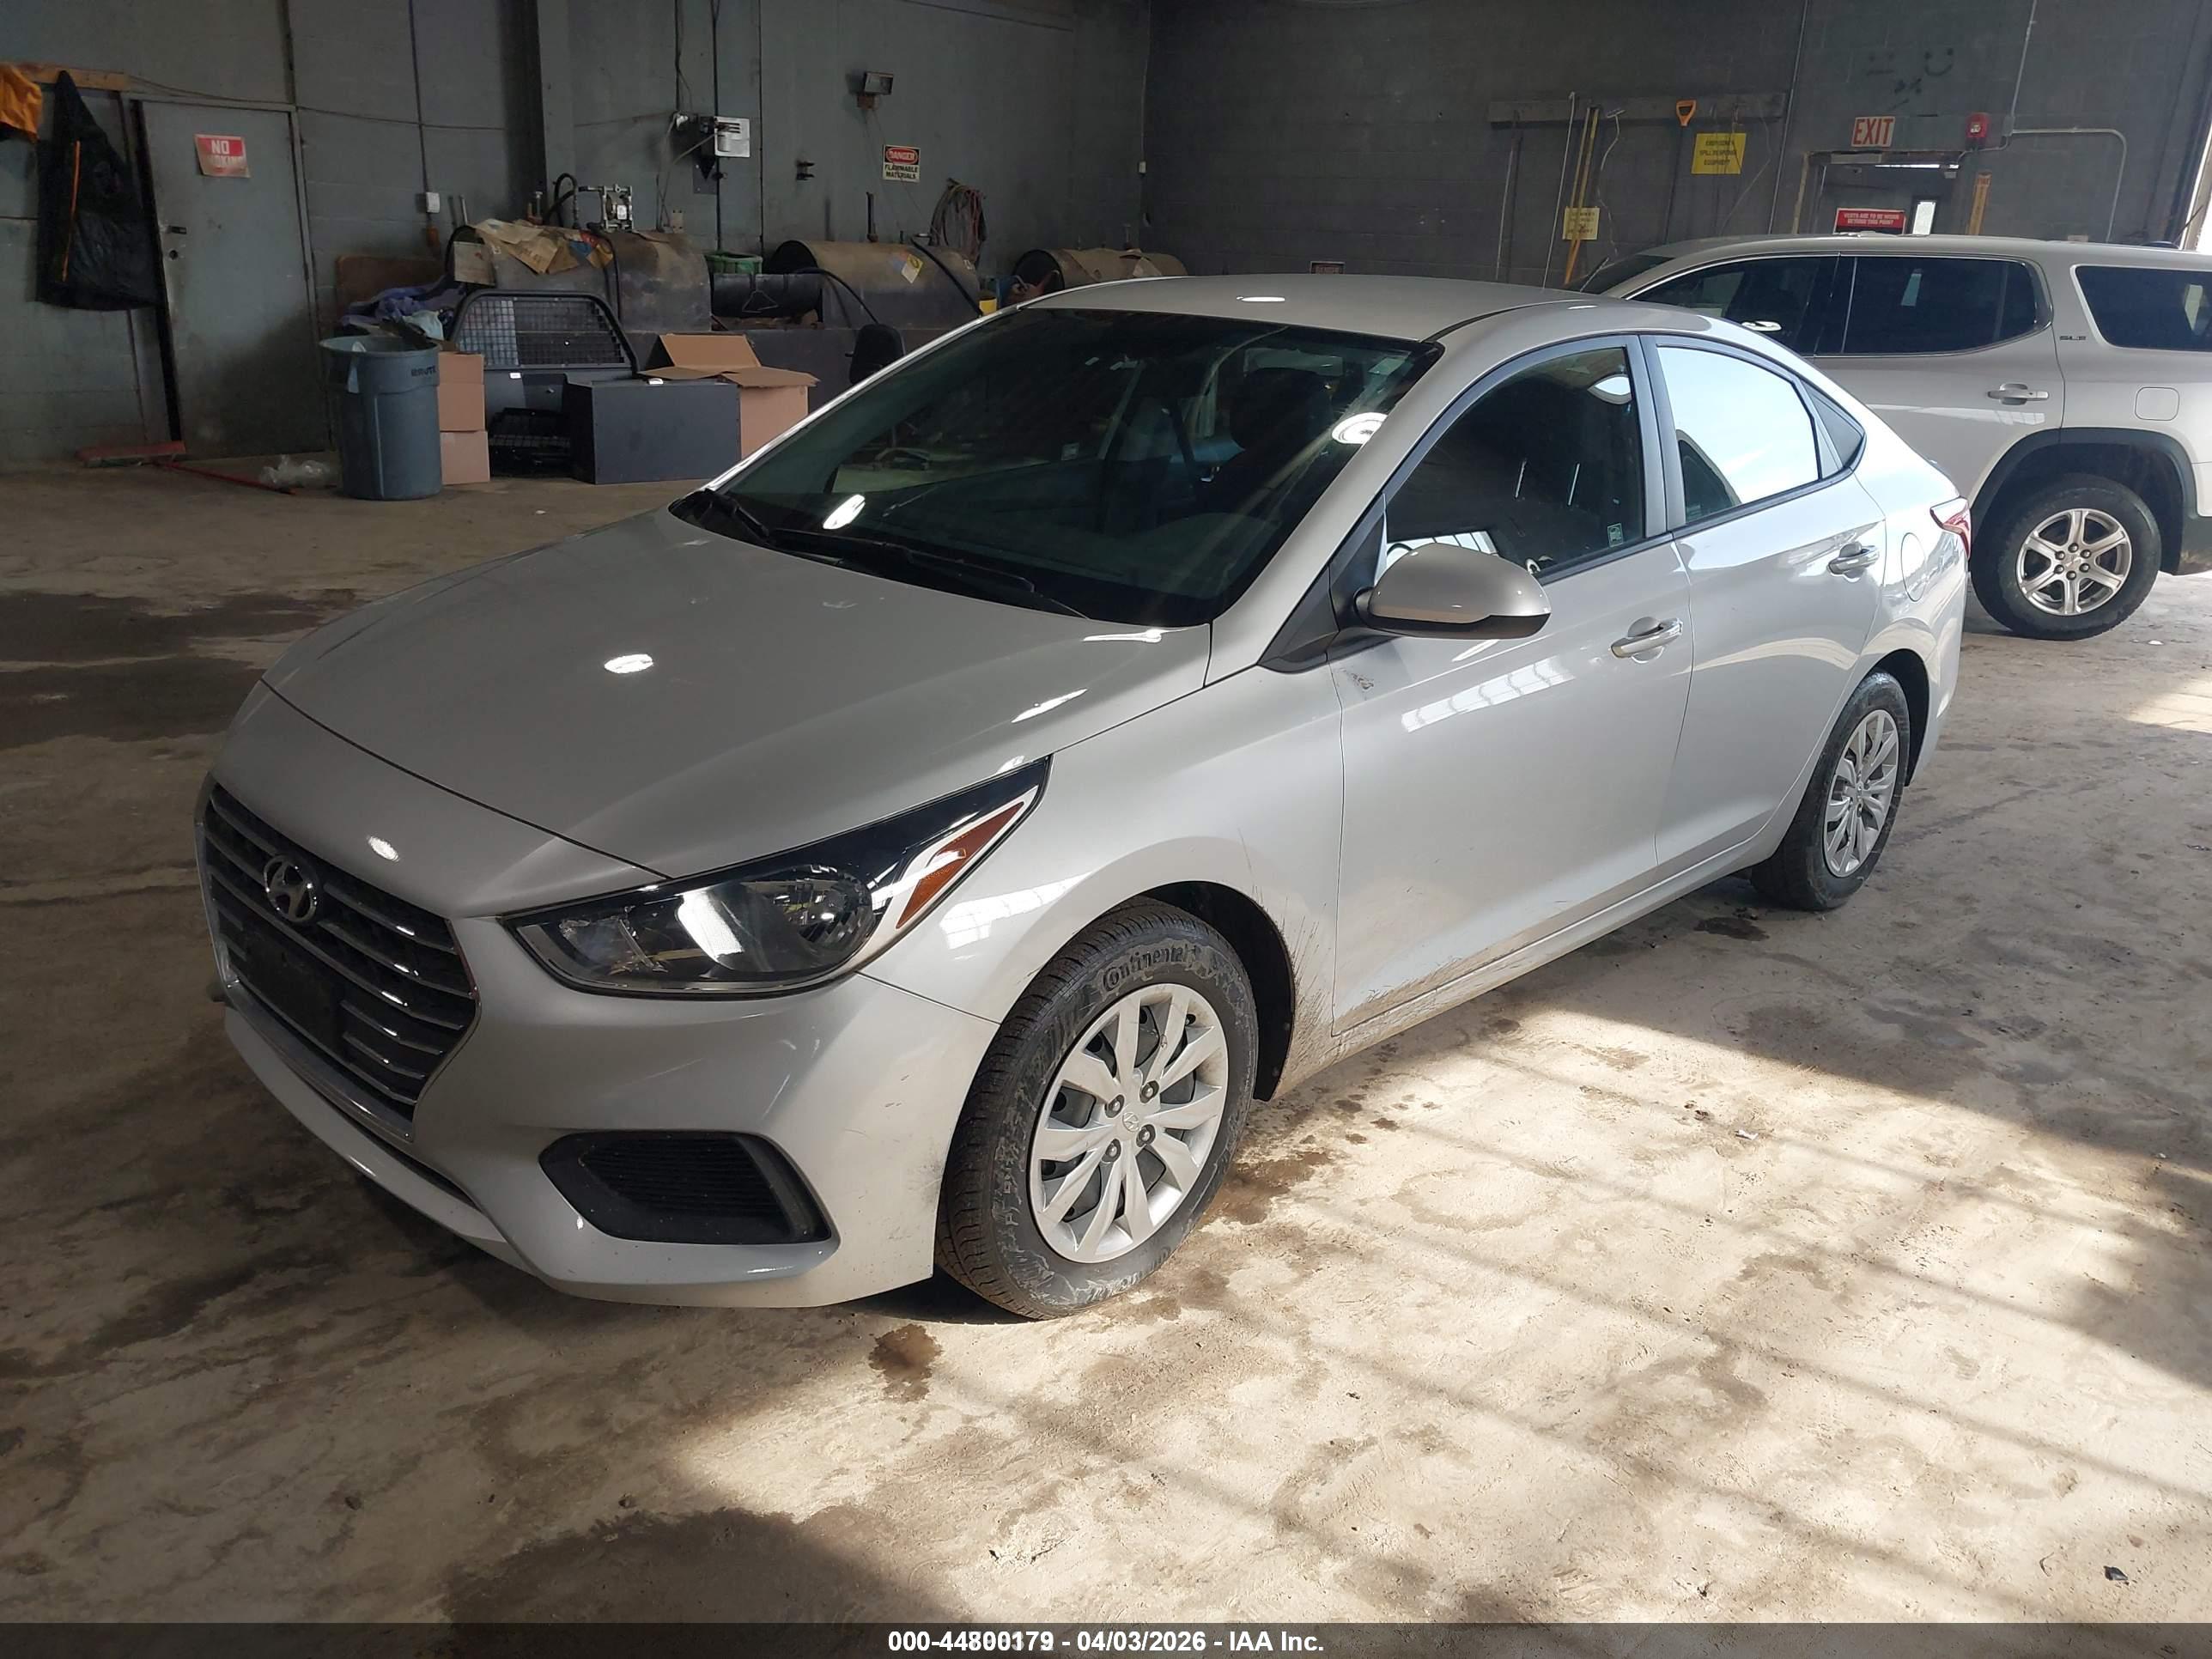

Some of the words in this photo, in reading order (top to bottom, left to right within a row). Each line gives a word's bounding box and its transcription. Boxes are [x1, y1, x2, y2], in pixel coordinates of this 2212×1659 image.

[1853, 118, 1894, 145] EXIT
[211, 140, 230, 155] NO
[888, 150, 915, 161] DANGER
[885, 164, 918, 173] FLAMMABLE
[1102, 942, 1188, 990] Continental
